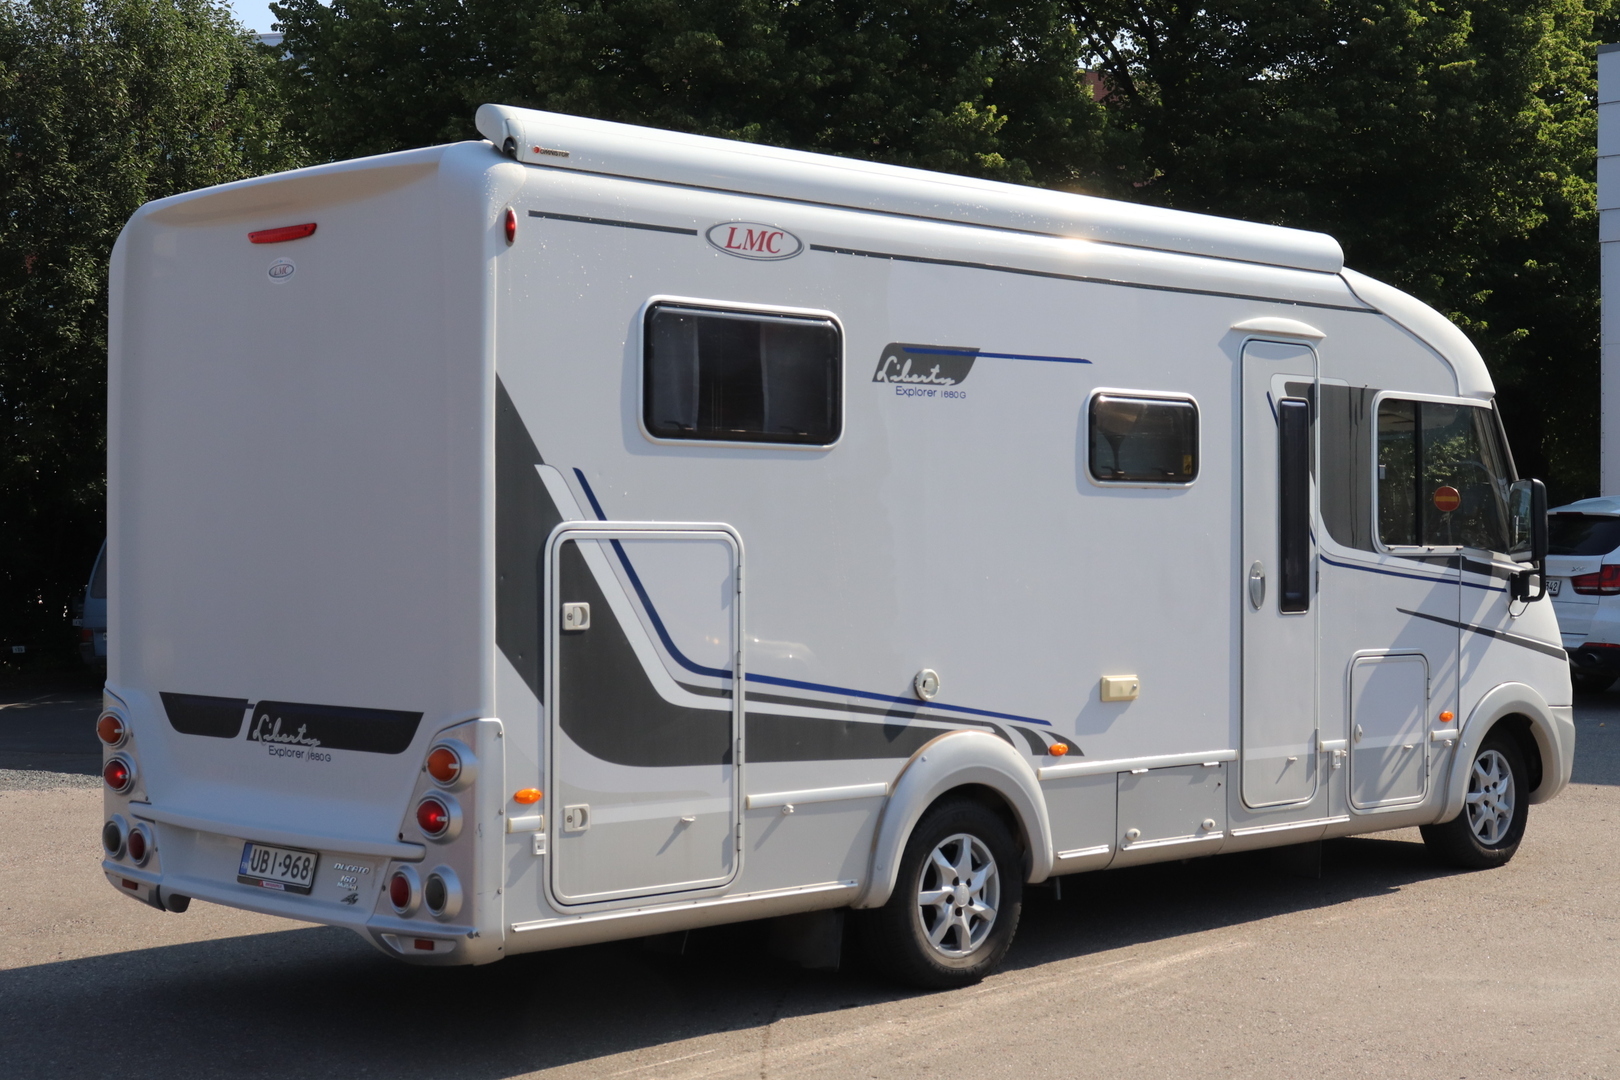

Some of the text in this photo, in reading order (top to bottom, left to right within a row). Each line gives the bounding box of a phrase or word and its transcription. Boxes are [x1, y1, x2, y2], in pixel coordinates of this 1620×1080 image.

[724, 226, 784, 254] LMC
[895, 385, 937, 398] Explorer
[268, 745, 305, 759] Explorer
[250, 848, 311, 881] UBI-968
[340, 875, 357, 885] 160
